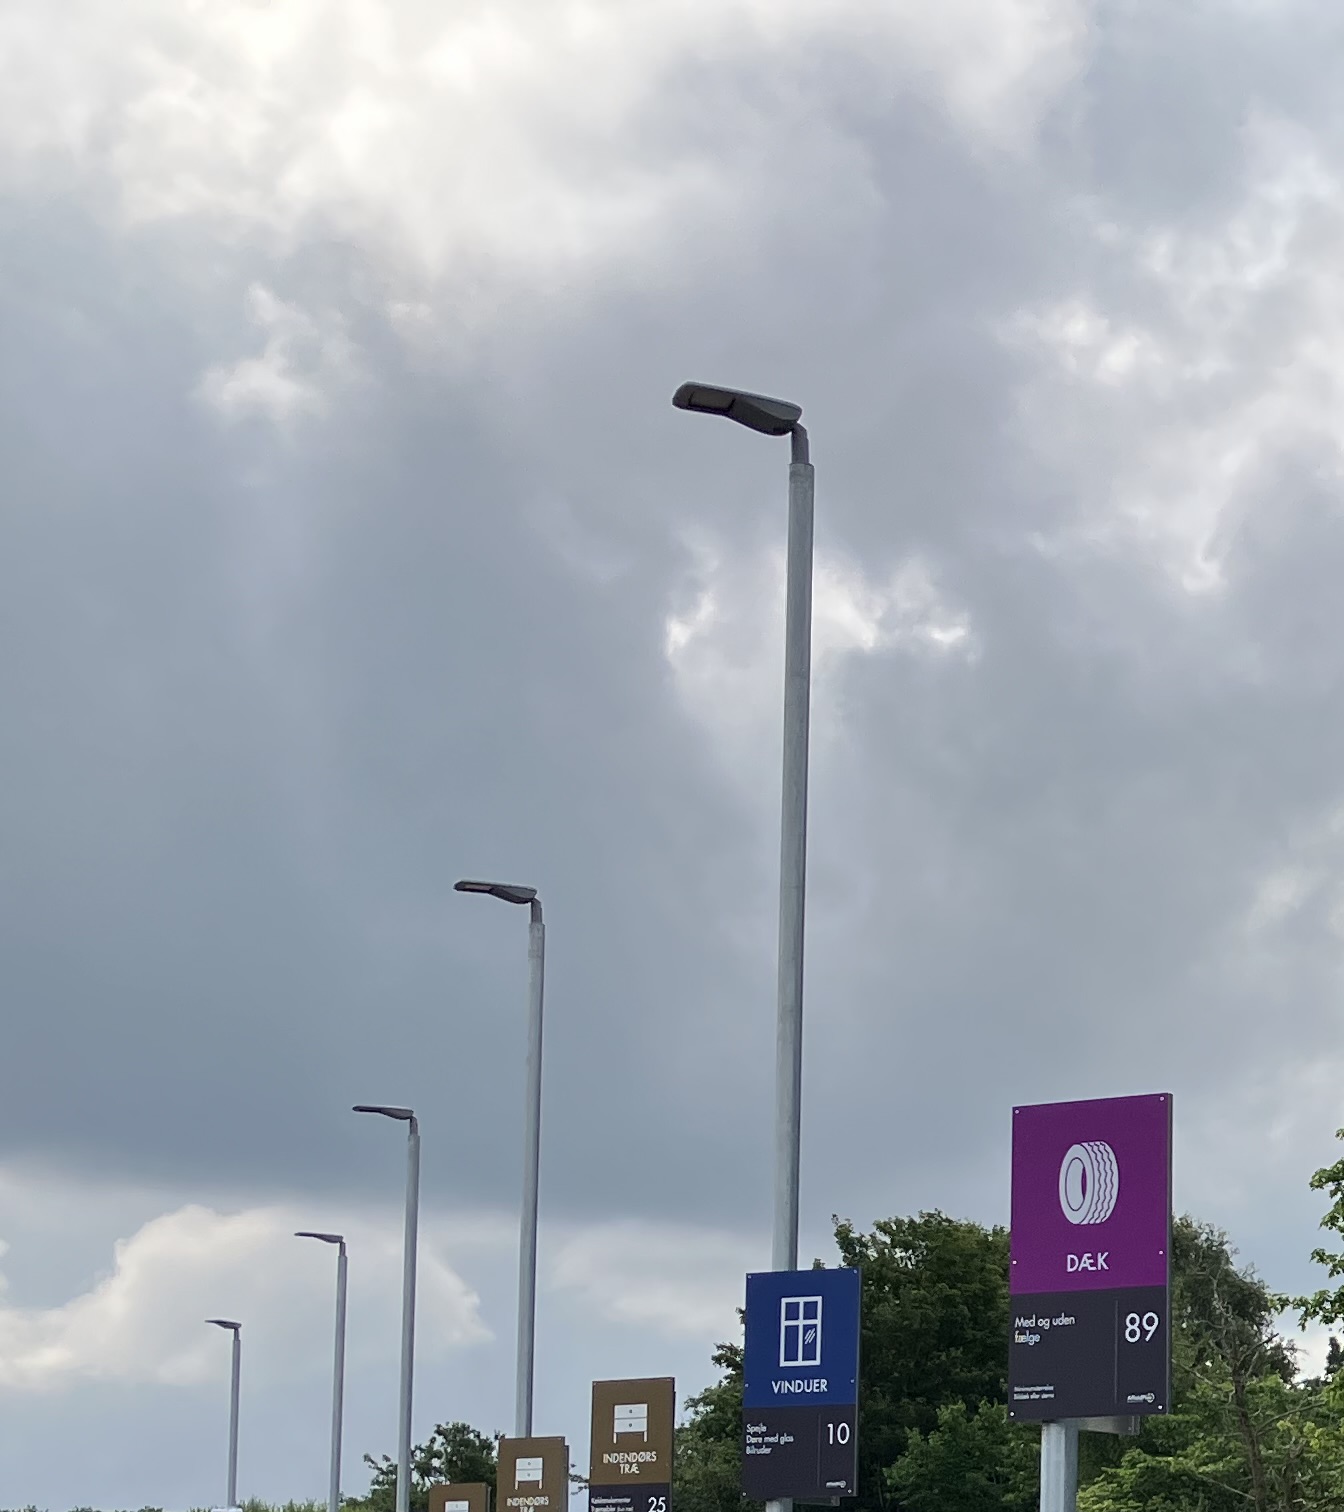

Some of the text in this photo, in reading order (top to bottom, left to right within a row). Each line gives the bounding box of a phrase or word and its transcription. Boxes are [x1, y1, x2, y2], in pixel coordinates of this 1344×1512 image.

[1067, 1252, 1109, 1272] DÆK
[1014, 1312, 1075, 1330] Med og uden
[1125, 1312, 1159, 1343] 89
[771, 1378, 828, 1394] VINDUER
[827, 1422, 850, 1445] 10
[603, 1451, 657, 1464] INDENDØRS
